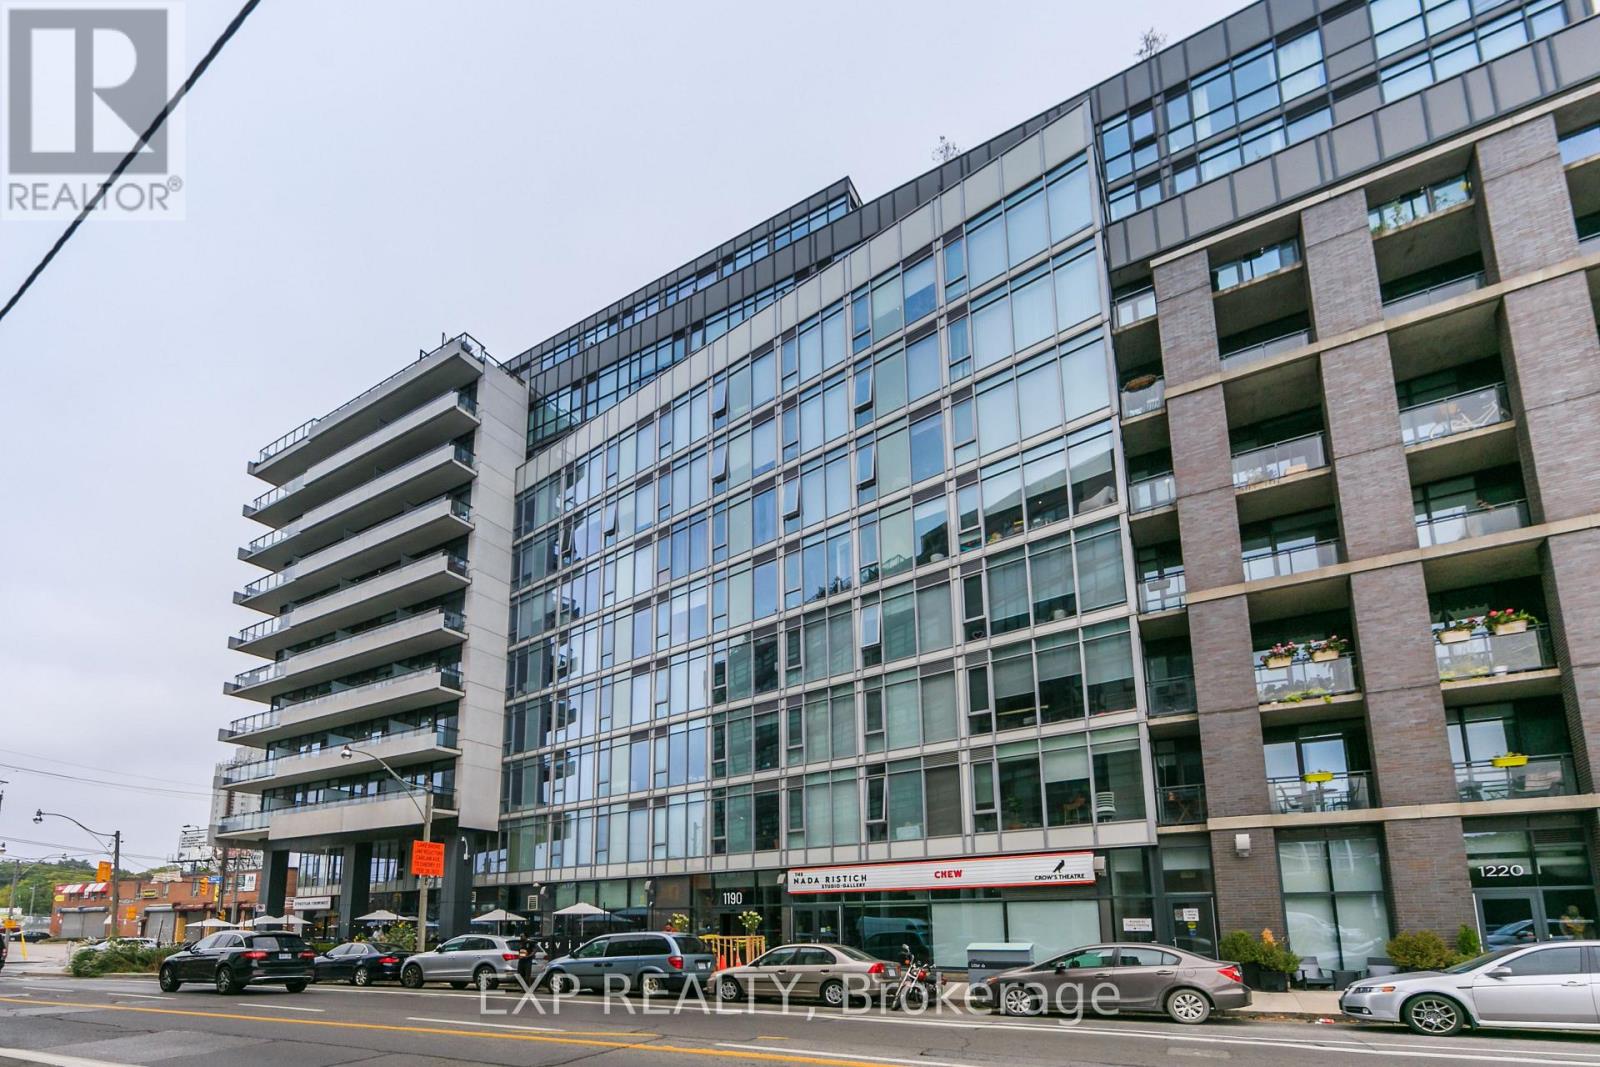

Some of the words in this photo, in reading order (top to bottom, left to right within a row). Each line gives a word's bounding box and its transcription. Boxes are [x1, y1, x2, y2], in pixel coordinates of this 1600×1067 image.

[934, 869, 963, 879] CHEW
[1478, 864, 1524, 877] 1220
[794, 877, 820, 885] NADA
[825, 874, 867, 883] RISTICH
[723, 891, 743, 905] 1190
